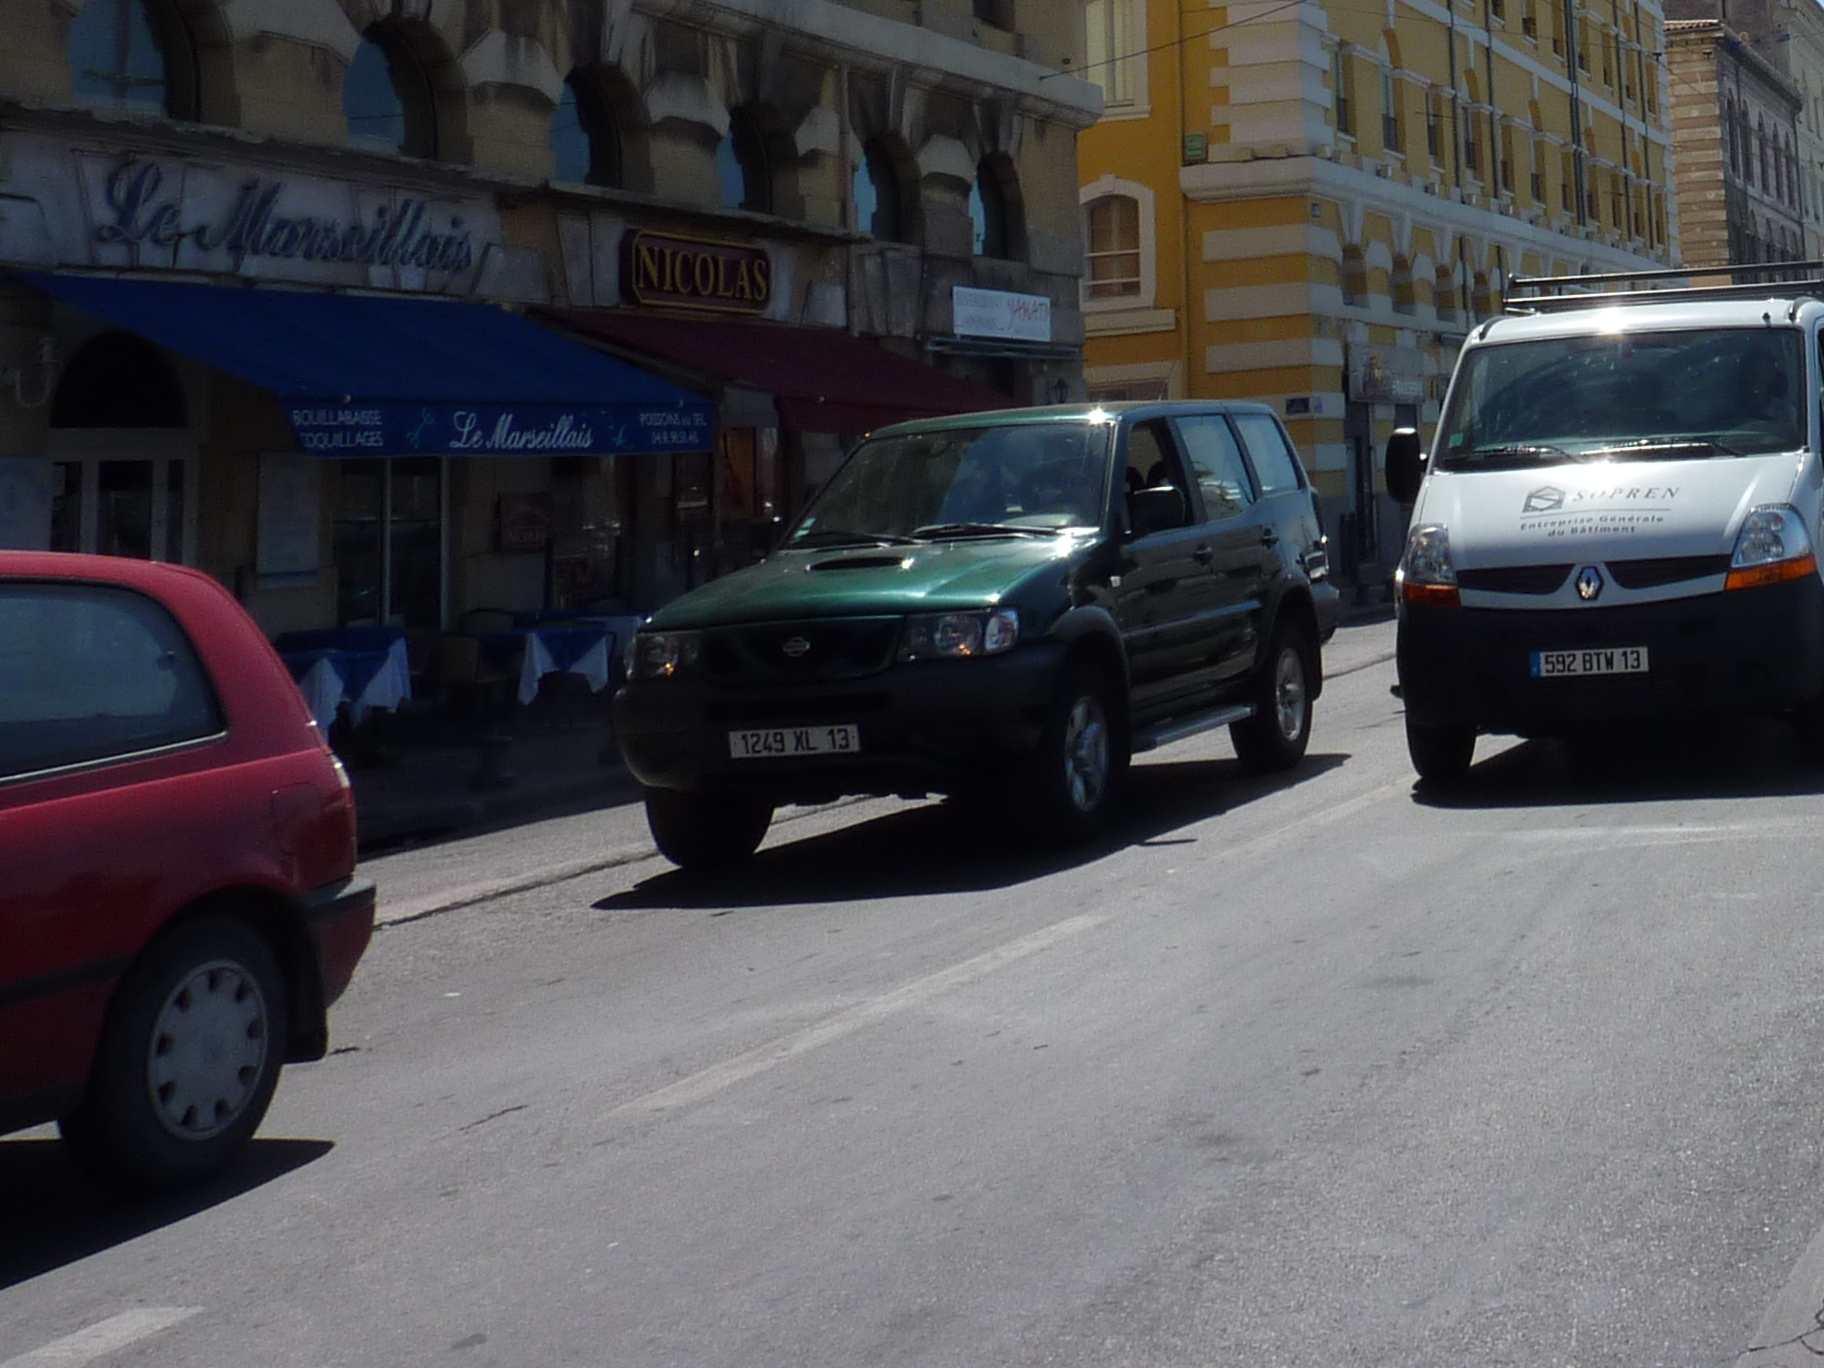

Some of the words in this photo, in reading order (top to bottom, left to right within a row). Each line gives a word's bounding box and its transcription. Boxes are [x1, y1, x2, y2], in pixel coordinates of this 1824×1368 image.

[97, 161, 179, 245] Le
[195, 177, 472, 271] Marseillais
[637, 246, 768, 301] NICOLAS
[292, 410, 383, 426] BOUILLABAISSE
[449, 411, 484, 449] Le
[486, 413, 594, 450] Marseillais
[1572, 487, 1680, 502] SOPREN
[1520, 517, 1593, 531] Entreprise
[1599, 514, 1664, 524] Générale
[1548, 528, 1565, 538] du
[1571, 525, 1636, 536] Bâtiment
[1545, 653, 1577, 673] 592
[1582, 651, 1614, 672] BTW
[1621, 650, 1641, 670] 13
[741, 732, 786, 754] 1249
[793, 730, 817, 752] XL
[828, 728, 850, 750] 13
